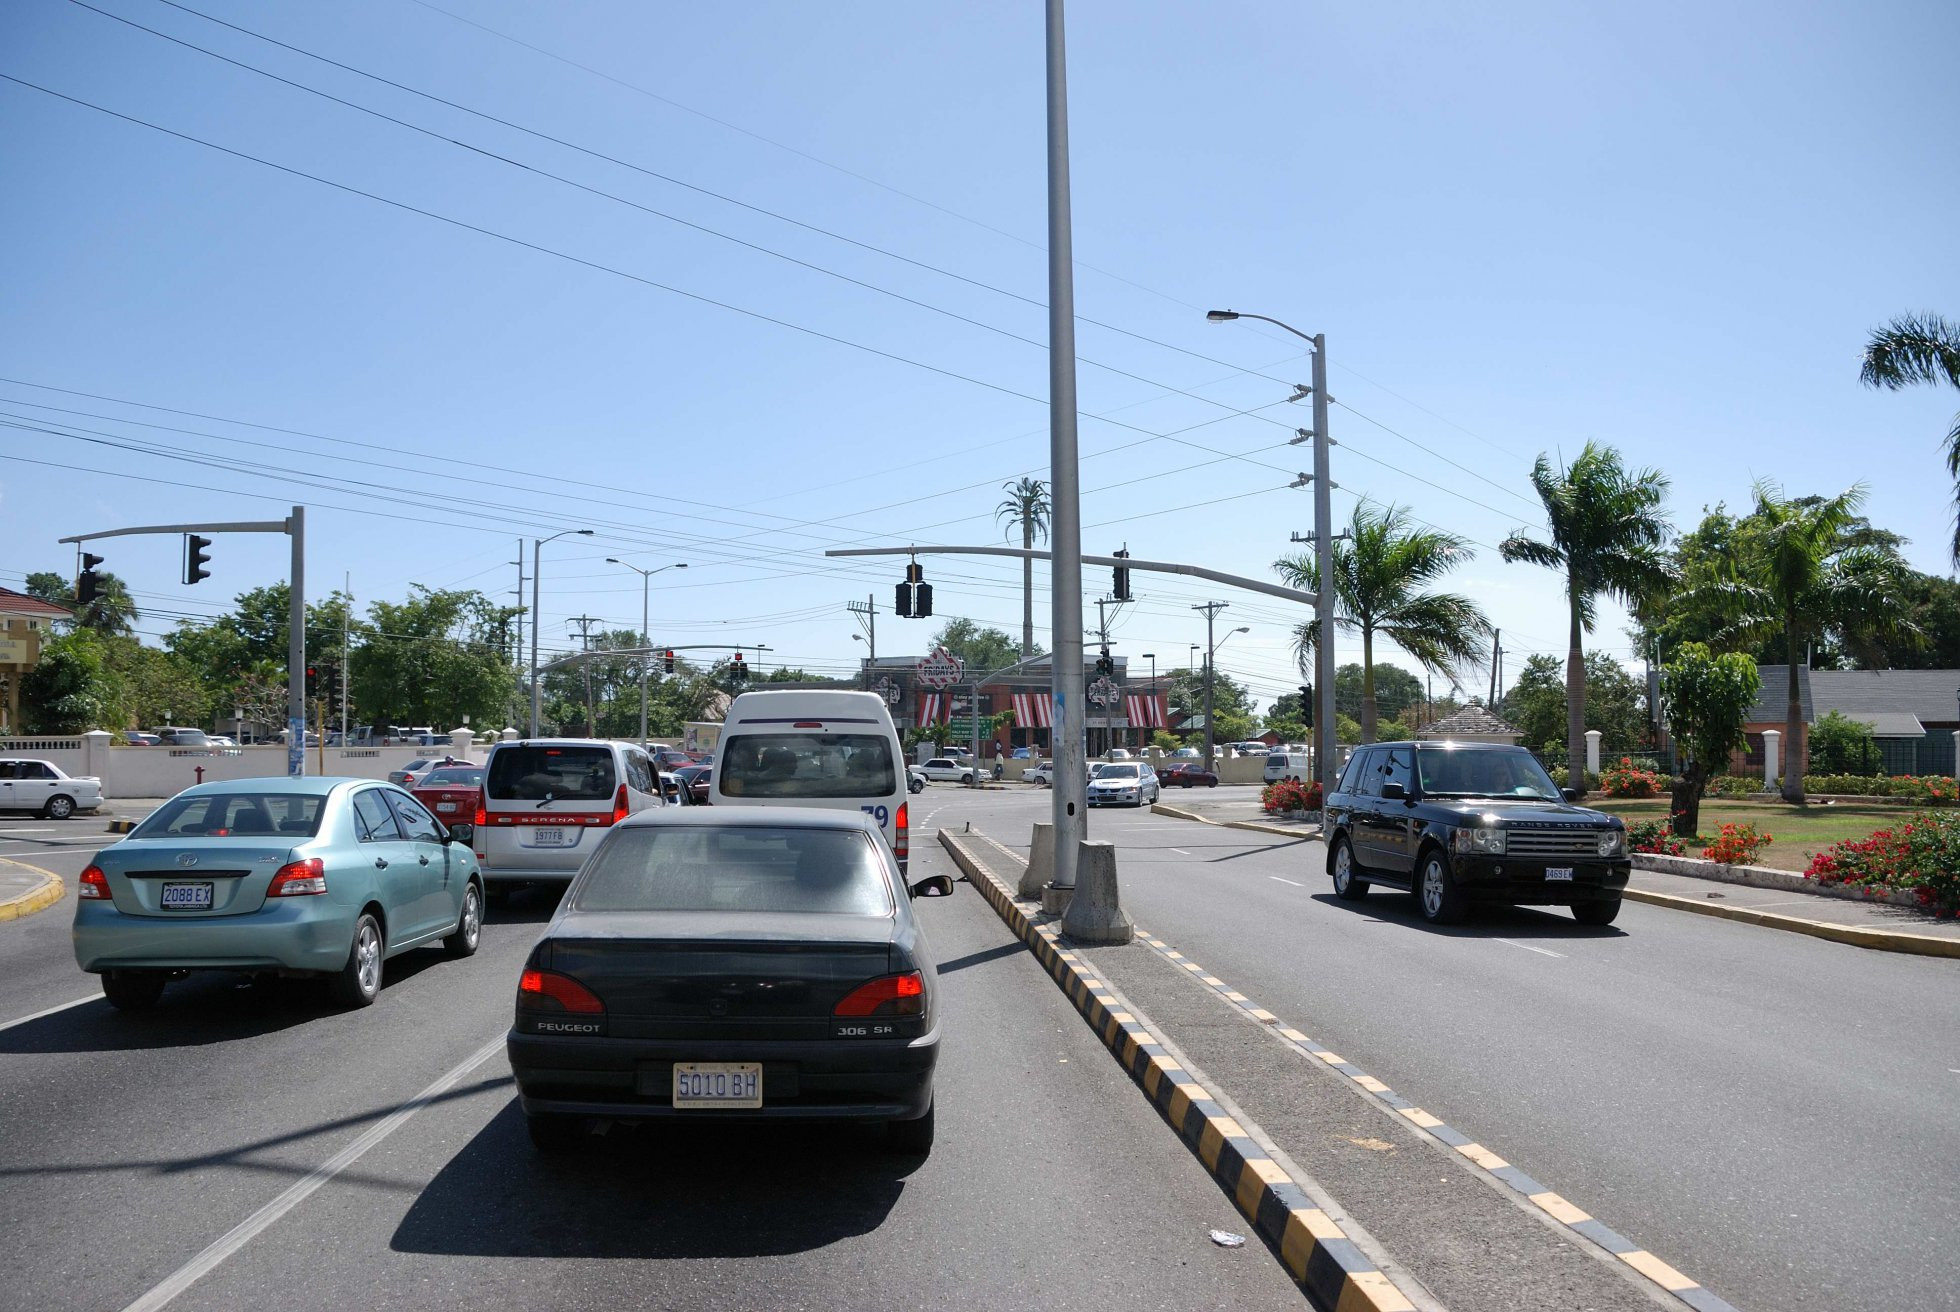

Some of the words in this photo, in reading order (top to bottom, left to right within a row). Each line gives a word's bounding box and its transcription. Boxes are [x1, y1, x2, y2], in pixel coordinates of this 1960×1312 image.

[164, 888, 193, 902] 2088
[538, 1023, 600, 1032] PEUGEOT
[837, 1027, 867, 1036] 306
[873, 1026, 893, 1034] SR
[680, 1074, 726, 1096] 5010
[733, 1074, 756, 1096] BH
